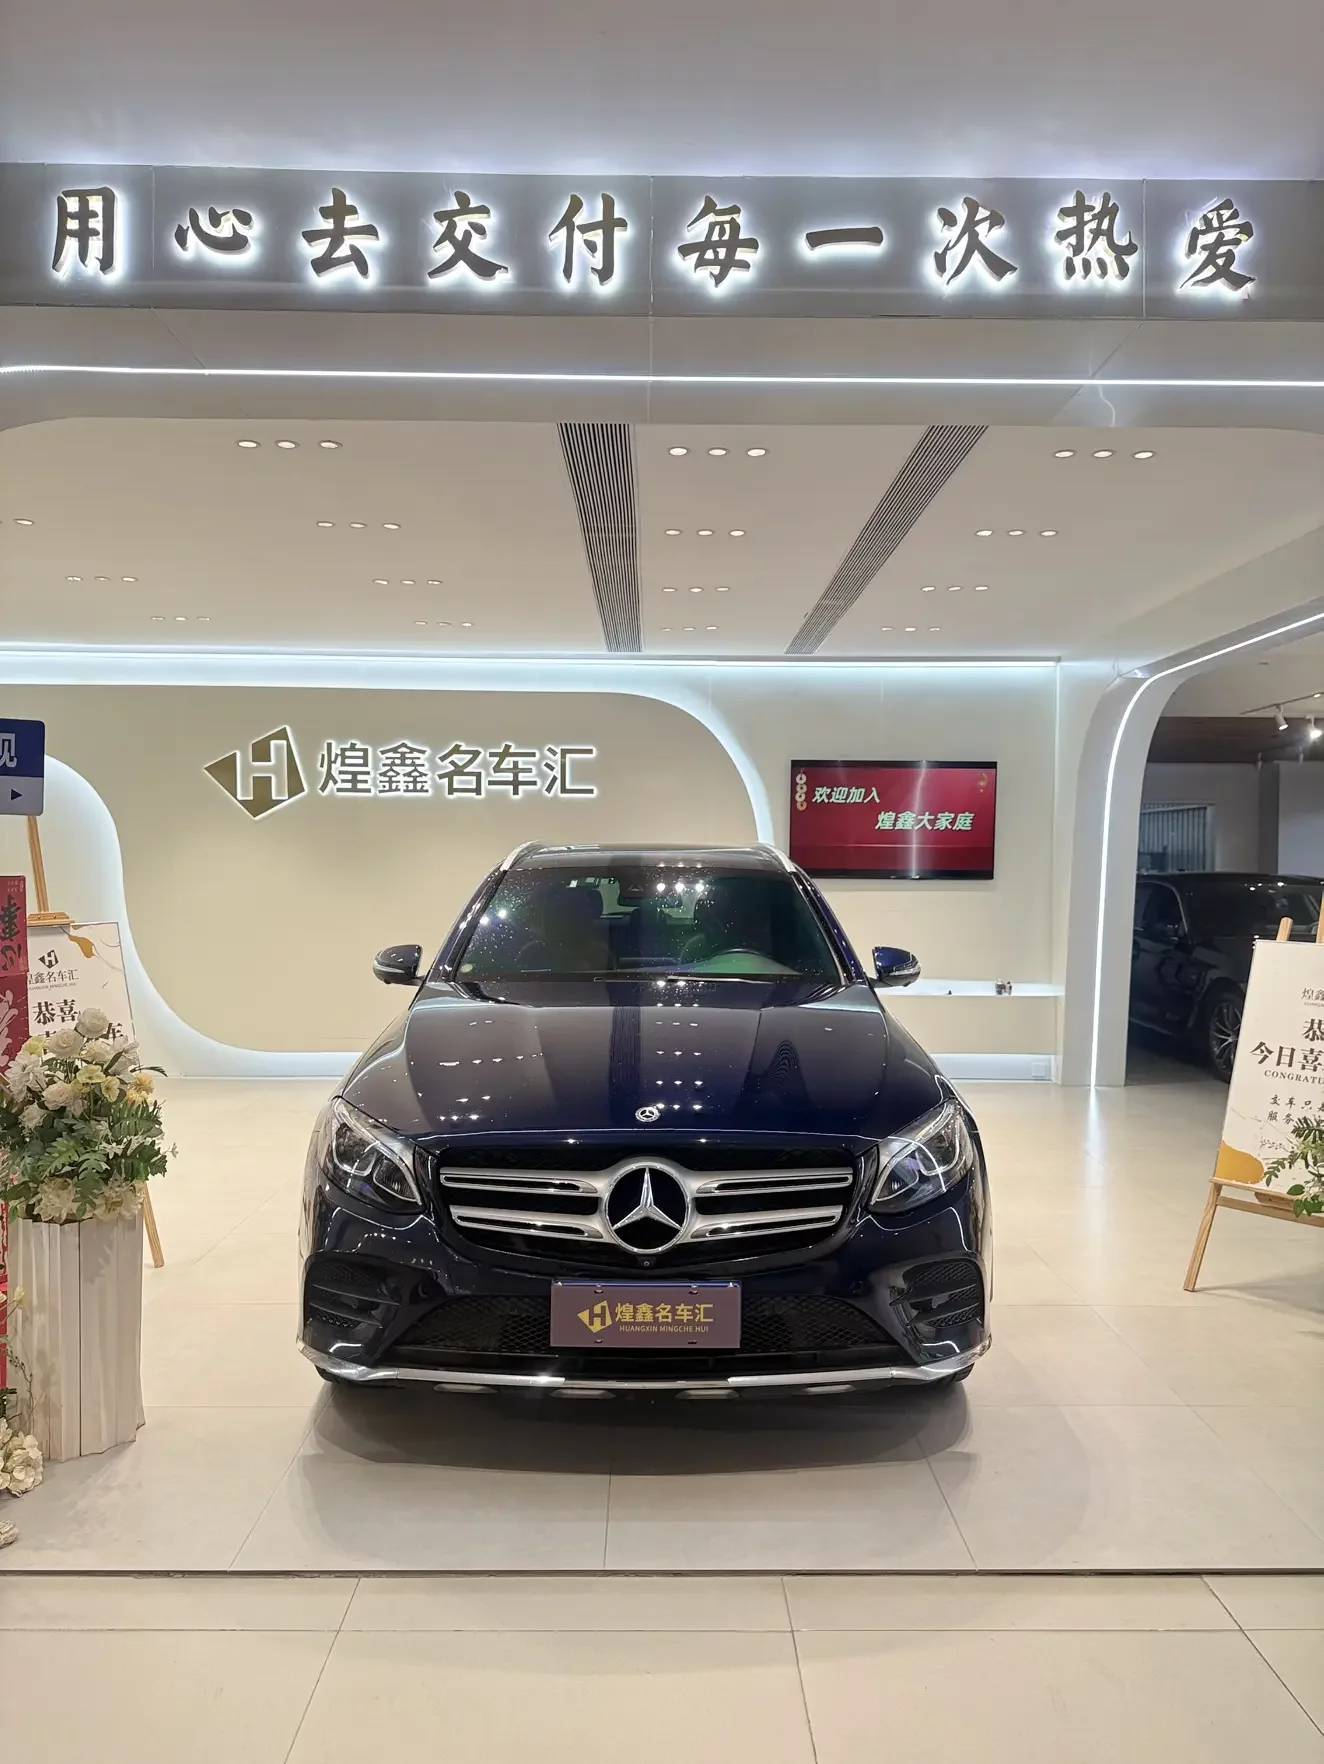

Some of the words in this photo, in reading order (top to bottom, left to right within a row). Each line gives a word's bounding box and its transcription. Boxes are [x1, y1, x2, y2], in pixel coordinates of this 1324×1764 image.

[52, 187, 1256, 292] 用心去交付每一次热爱
[319, 741, 595, 797] 煌鑫名车汇
[812, 786, 881, 804] 欢迎加入
[875, 811, 975, 831] 煌鑫大家庭
[1250, 1041, 1324, 1073] 今日喜
[615, 1303, 714, 1323] 煌鑫名车汇
[619, 1325, 658, 1333] HUANGXIN
[659, 1325, 693, 1333] MINGCHE
[695, 1325, 709, 1333] HUI
